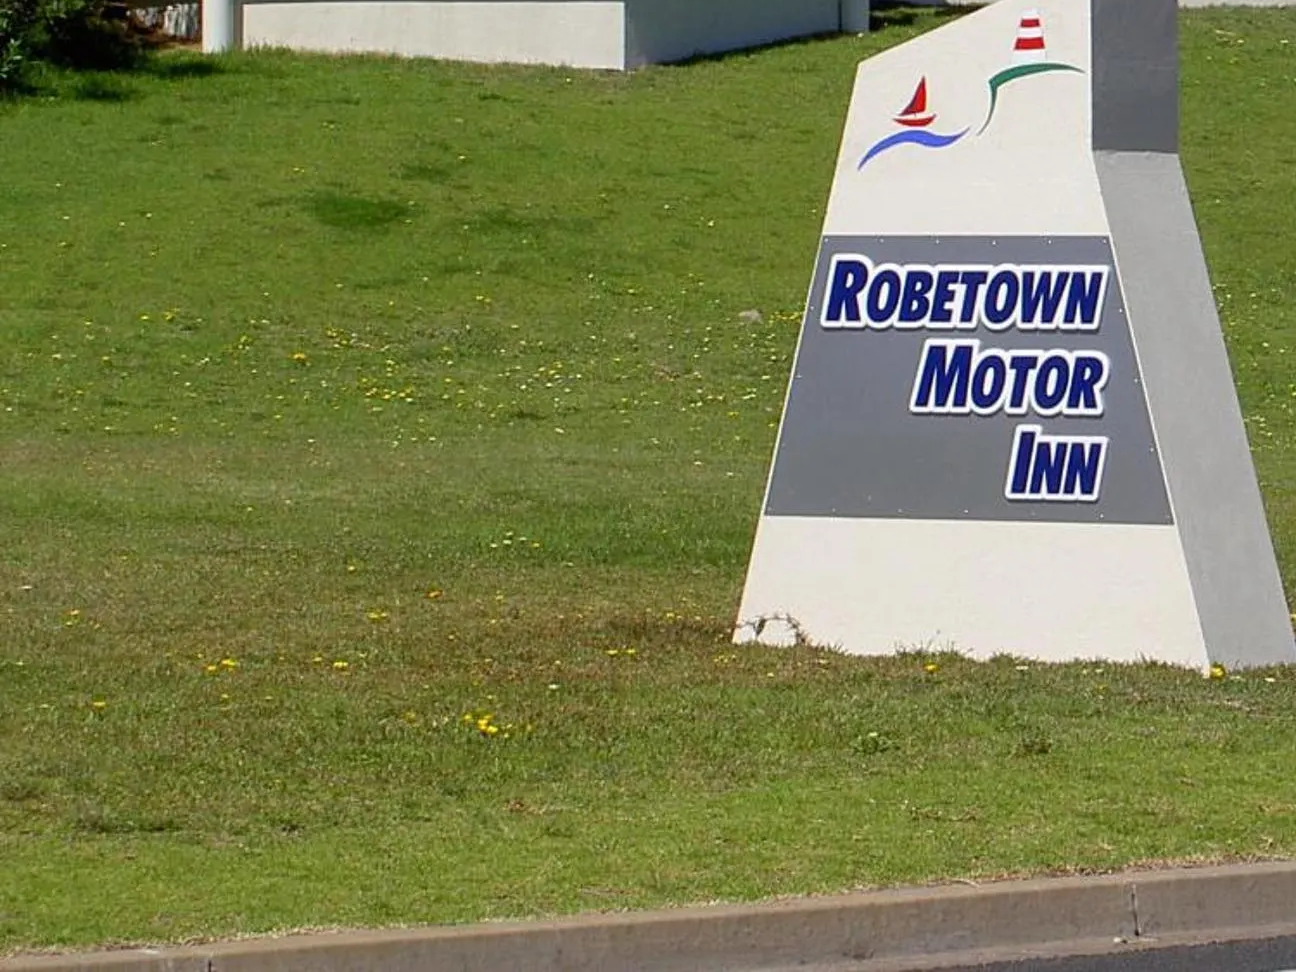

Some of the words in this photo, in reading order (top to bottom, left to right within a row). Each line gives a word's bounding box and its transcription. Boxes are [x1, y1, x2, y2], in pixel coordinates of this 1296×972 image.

[823, 256, 1106, 327] ROBETOWN
[912, 342, 1105, 412] MOTOR
[1007, 427, 1105, 498] INN
